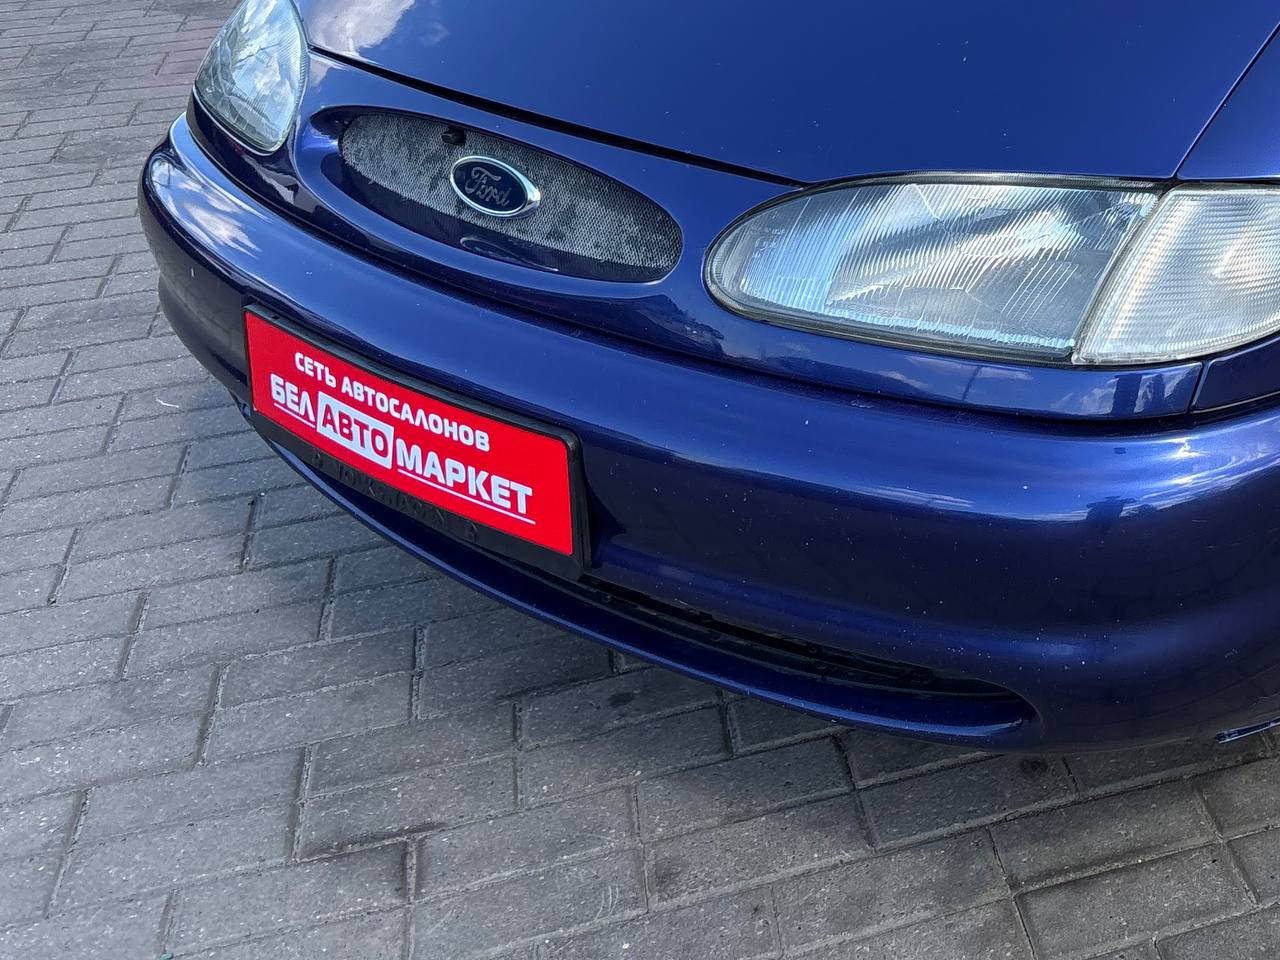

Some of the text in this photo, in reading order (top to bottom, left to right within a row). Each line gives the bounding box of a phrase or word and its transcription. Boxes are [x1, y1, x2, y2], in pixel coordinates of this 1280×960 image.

[466, 167, 510, 206] Ford
[295, 352, 490, 452] СЕТЬ АВТОСАЛОНОВ
